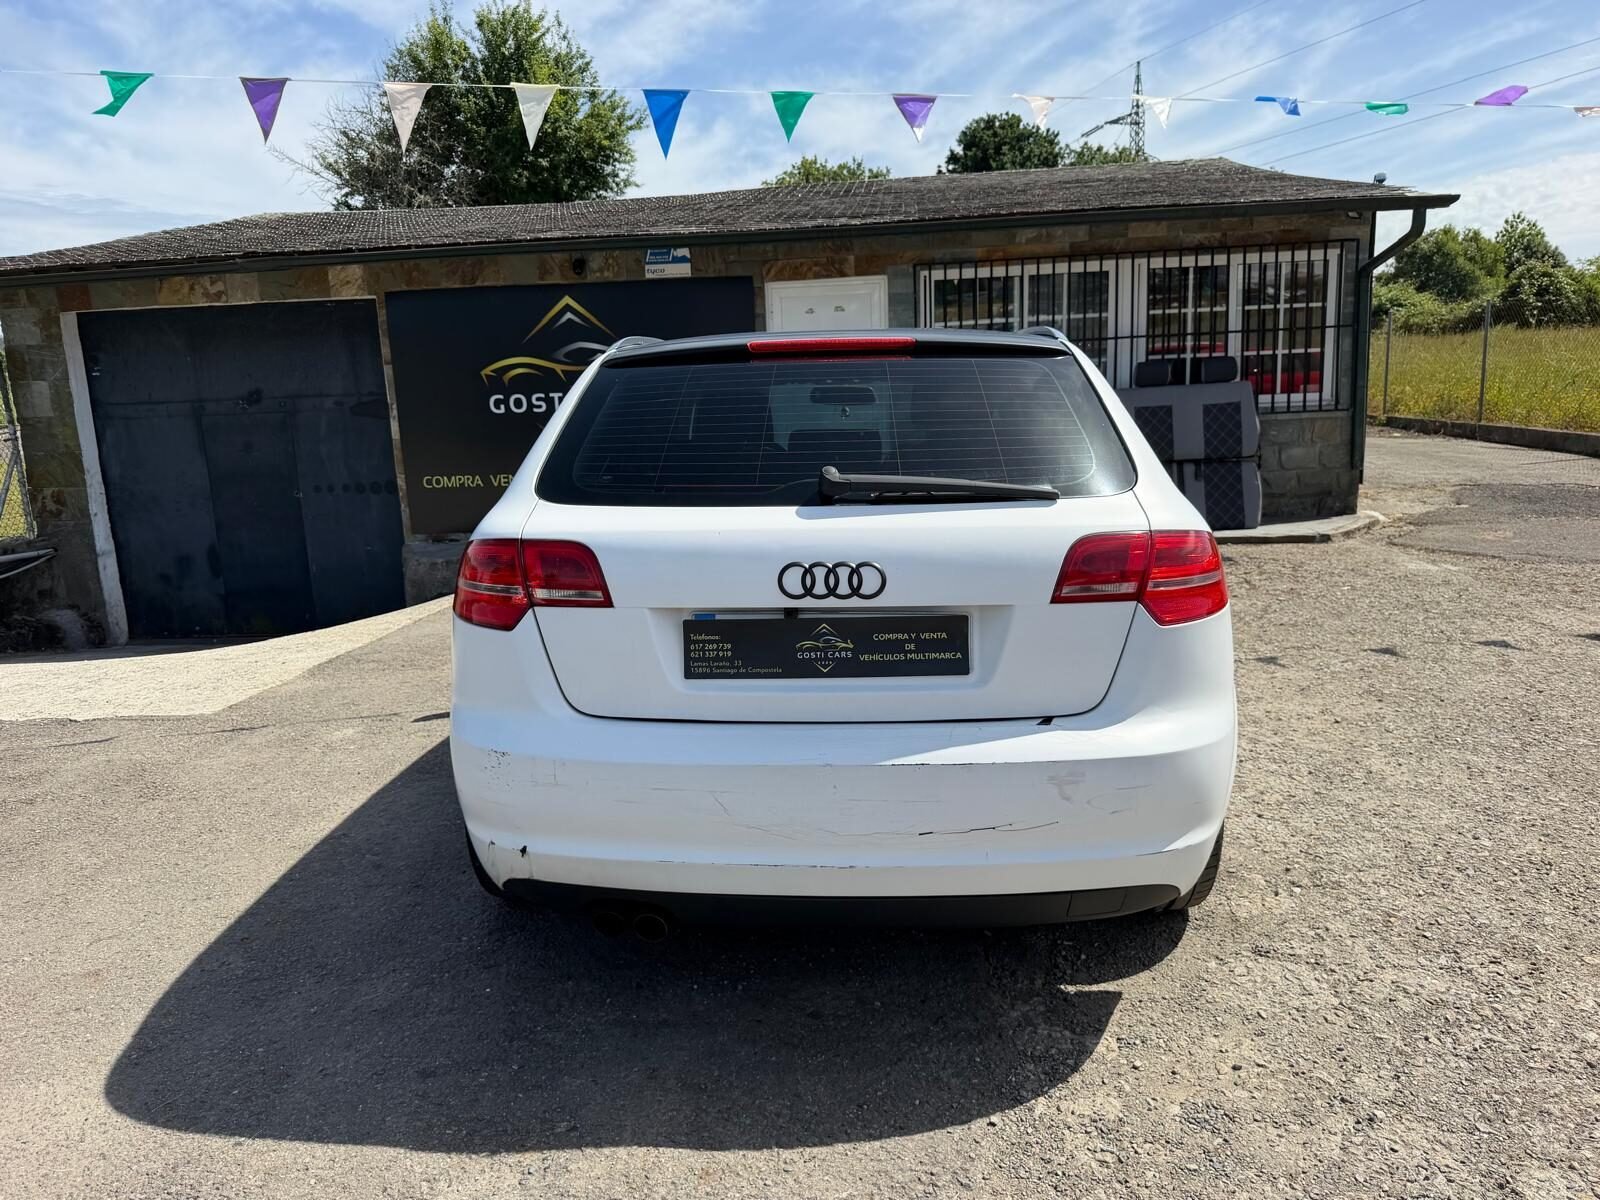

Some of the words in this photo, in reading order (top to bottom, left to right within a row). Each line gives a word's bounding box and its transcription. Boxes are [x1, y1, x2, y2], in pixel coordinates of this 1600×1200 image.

[423, 474, 483, 489] COMPRA
[872, 633, 909, 641] COMPRA
[919, 632, 948, 640] VENTA
[858, 652, 905, 661] VEHÍCULOS
[906, 652, 963, 661] MULTIMARCA
[712, 667, 737, 675] Santiago
[747, 666, 783, 675] Compostela
